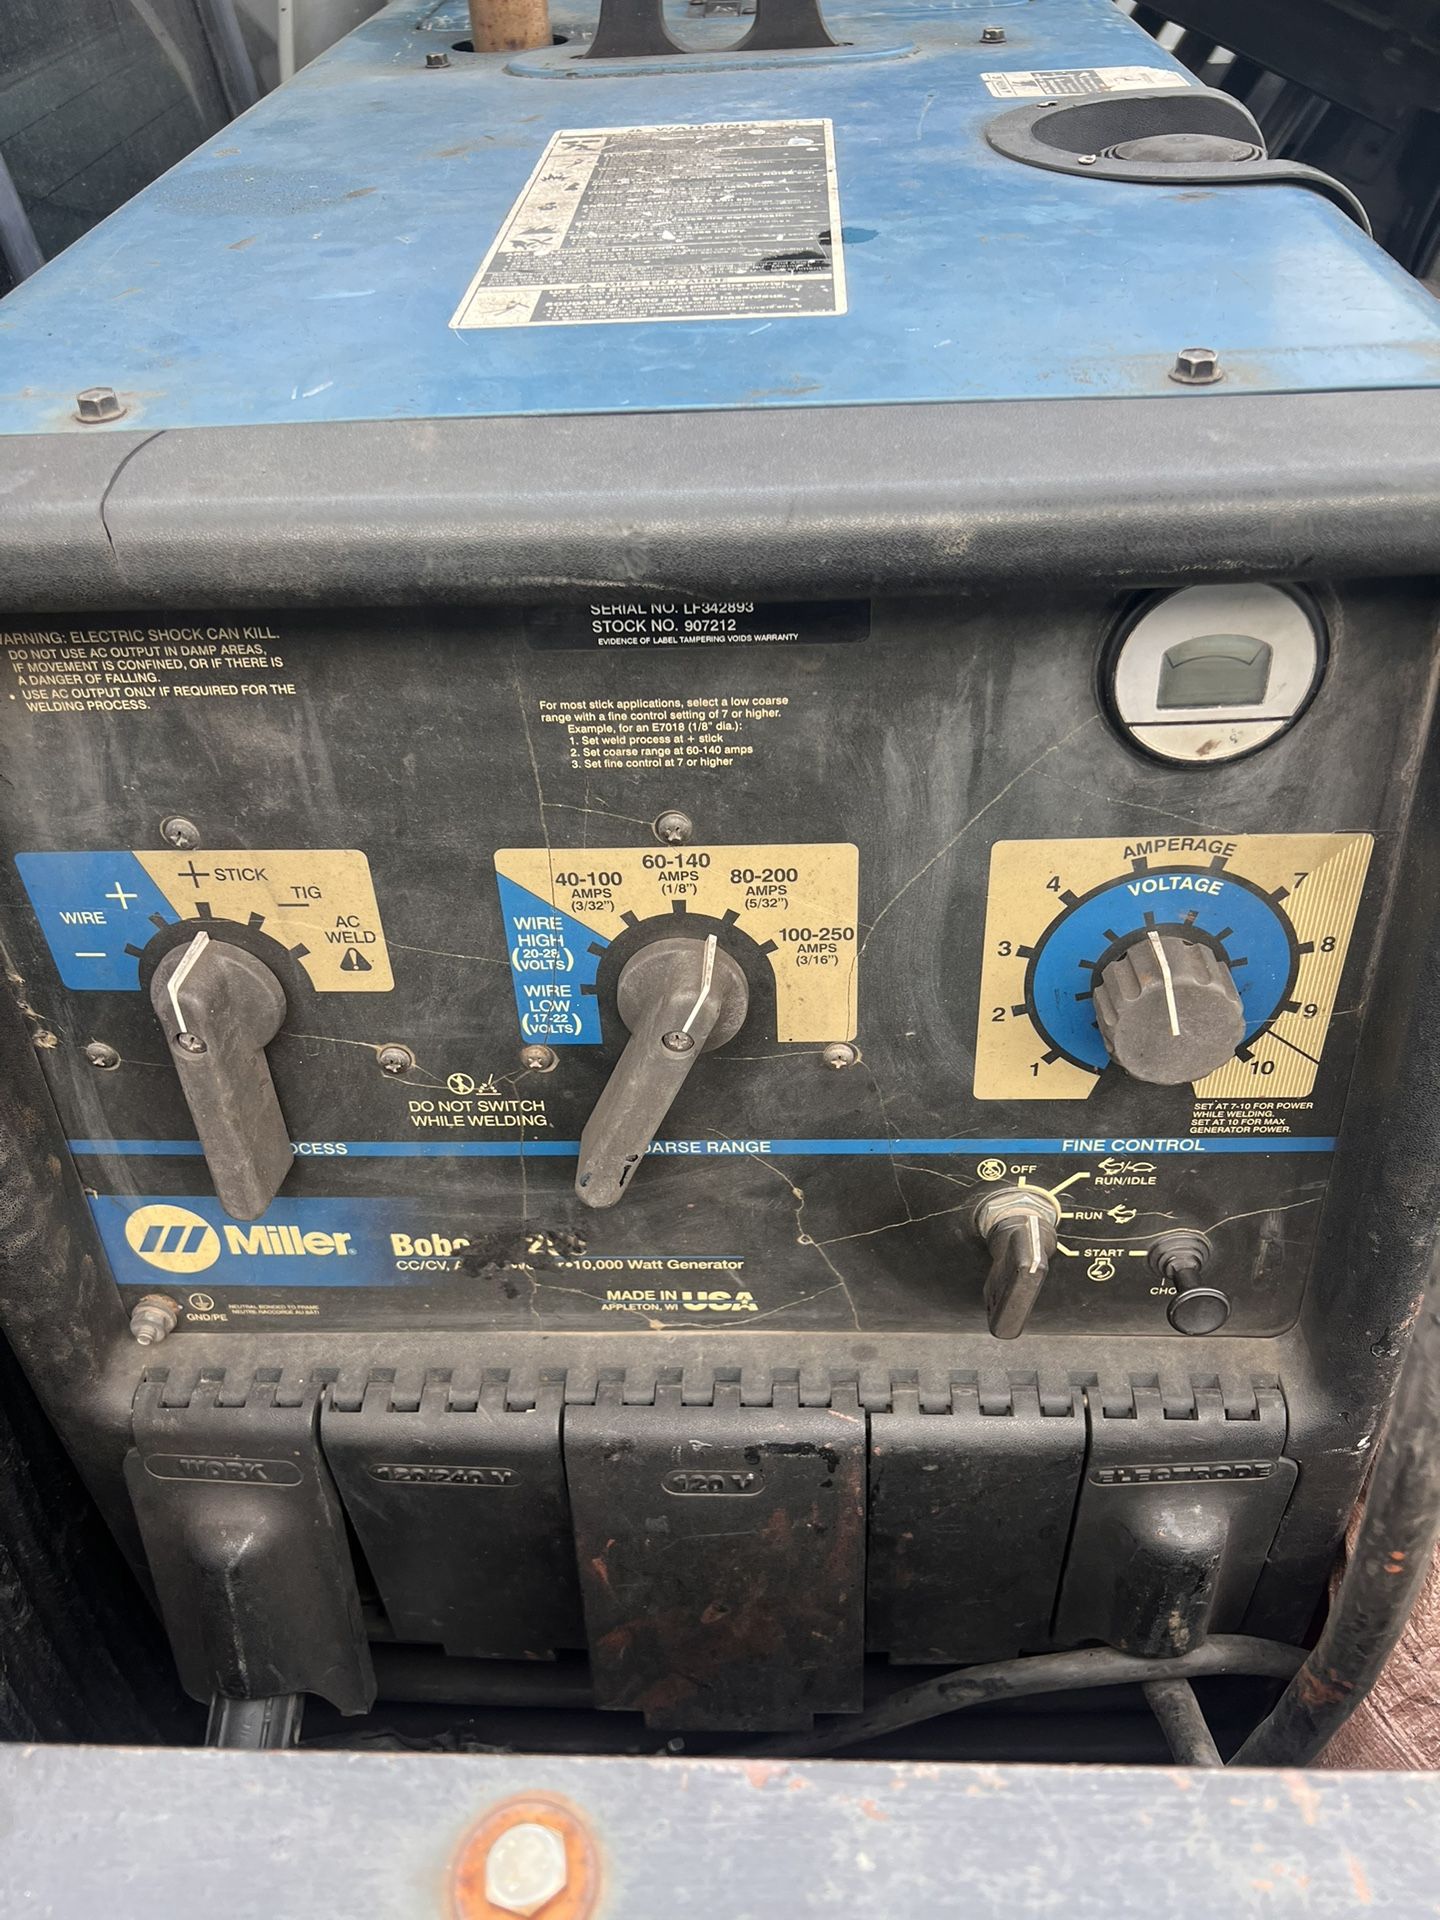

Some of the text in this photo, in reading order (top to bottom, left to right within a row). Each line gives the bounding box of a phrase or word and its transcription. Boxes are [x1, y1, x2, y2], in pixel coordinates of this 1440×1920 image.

[590, 602, 754, 616] SERIAL NO. LF342893
[592, 619, 737, 633] STOCK NO. 907212
[0, 627, 280, 645] ARNING: ELECTRIC SHOCK CAN KILL.
[598, 633, 799, 646] EVIDENCE OF LABEL TAMPERING VOIDS WARRANTY
[8, 644, 267, 660] DO NOT USE AC OUTPUT IN DAMP AREAS,
[12, 657, 284, 673] IF MOVEMENT IS CONFINED, OR IF THERE IS
[18, 672, 161, 686] A DANGER OF FALLING.
[22, 684, 296, 700] USE AC OUTPUT ONLY IF REQUIRED FOR THE
[26, 700, 151, 712] WELDING PROCESS.
[540, 700, 557, 710] For
[560, 700, 586, 710] most
[589, 700, 614, 709] stick
[617, 698, 684, 710] applications,
[687, 698, 718, 707] select
[731, 697, 749, 706] low
[752, 697, 789, 706] coarse
[619, 724, 633, 733] for
[652, 722, 685, 732] E7018
[716, 721, 743, 732] dia.):
[1124, 837, 1238, 859] AMPERAGE
[642, 853, 711, 869] 60-140
[215, 868, 268, 882] STICK
[556, 872, 623, 887] 40-100
[658, 871, 699, 881] AMPS
[730, 868, 798, 884] 80-200
[1293, 872, 1309, 889] 7
[662, 884, 697, 896] (1/8")
[1046, 875, 1061, 892] 4
[1128, 876, 1224, 897] VOLTAGE
[291, 886, 322, 899] TIG
[572, 888, 612, 899] AMPS
[746, 885, 787, 896] AMPS
[572, 900, 615, 912] (3/32")
[745, 898, 789, 910] (5/32")
[59, 912, 107, 925] WIRE
[336, 916, 361, 928] AC
[513, 917, 564, 930] WIRE
[325, 931, 376, 944] WELD
[518, 934, 564, 947] HIGH
[779, 928, 854, 942] 100-250
[797, 944, 837, 953] AMPS
[997, 941, 1012, 957] 3
[1320, 936, 1336, 953] 8
[796, 955, 839, 966] (3/16")
[524, 985, 572, 997] WIRE
[530, 1000, 570, 1012] LOW
[1303, 1003, 1318, 1019] 9
[992, 1007, 1006, 1022] 2
[1030, 1063, 1040, 1077] 1
[1250, 1060, 1275, 1075] 10
[408, 1100, 545, 1112] DO NOT SWITCH
[1231, 1102, 1251, 1110] 7-10
[1253, 1102, 1274, 1110] FOR
[1276, 1102, 1314, 1110] POWER
[1192, 1110, 1275, 1118] WHILE WELDING.
[411, 1115, 547, 1127] WHILE WELDING
[1191, 1118, 1210, 1126] SET
[1212, 1118, 1226, 1126] AT
[1228, 1118, 1239, 1126] 10
[1240, 1118, 1262, 1126] FOR
[1190, 1126, 1251, 1134] GENERATOR
[290, 1143, 348, 1155] OCESS
[645, 1141, 772, 1153] ARSE RANGE
[1062, 1139, 1205, 1152] FINE CONTROL
[1010, 1166, 1037, 1174] OFF
[1094, 1176, 1157, 1186] RUN/IDLE
[1075, 1212, 1103, 1220] RUN
[223, 1225, 351, 1256] Miller
[1084, 1249, 1124, 1257] START
[396, 1260, 450, 1272] CC/CV,
[628, 1259, 668, 1270] Watt
[667, 1259, 744, 1271] Generator
[606, 1290, 677, 1301] MADE IN
[1150, 1286, 1177, 1295] CHO
[602, 1304, 663, 1312] APPLETON,
[682, 1291, 759, 1312] USA
[186, 1313, 229, 1322] GND/PE
[180, 1459, 268, 1480] WORK
[1099, 1464, 1272, 1483] ELECTRODE
[673, 1473, 755, 1492] 120 V
